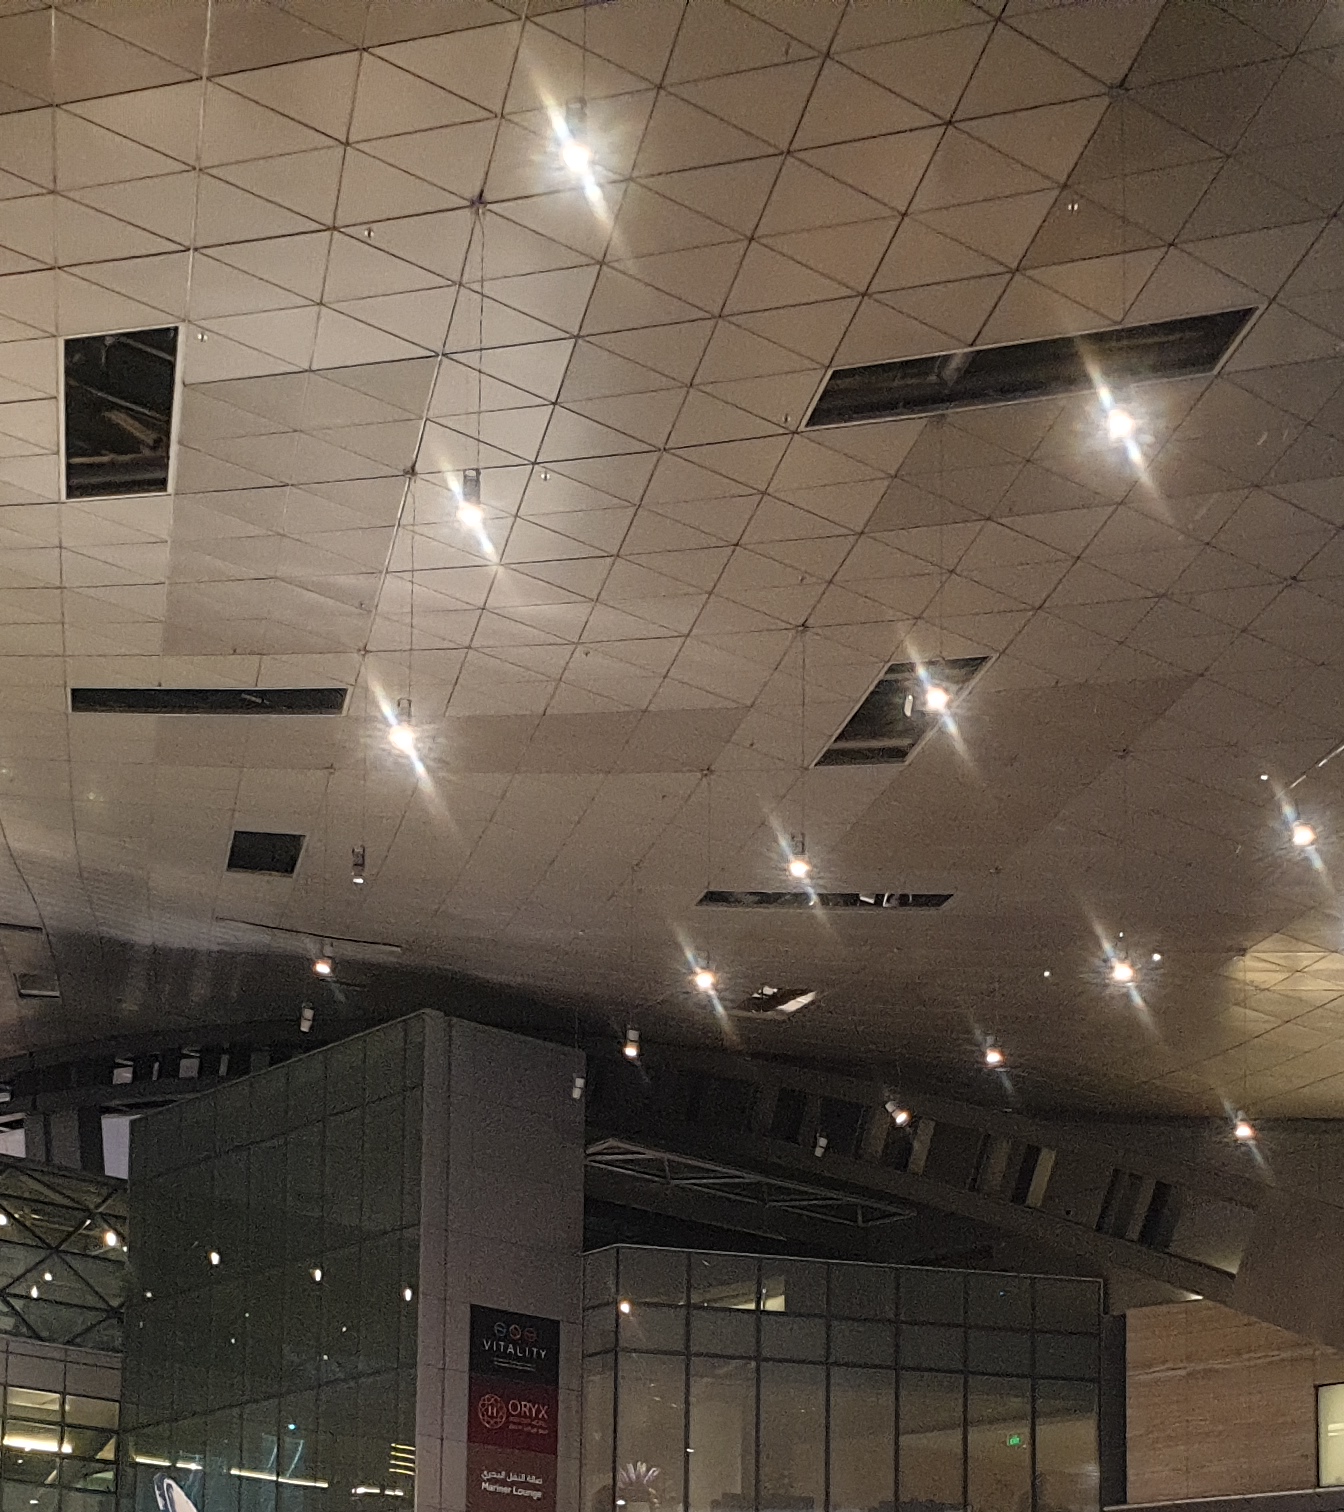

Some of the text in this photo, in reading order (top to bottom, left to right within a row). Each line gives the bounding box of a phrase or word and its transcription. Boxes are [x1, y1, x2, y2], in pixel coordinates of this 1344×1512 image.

[483, 1339, 547, 1359] VITALITY
[508, 1400, 549, 1419] ORYX
[481, 1481, 542, 1500] Mariner Lounge
